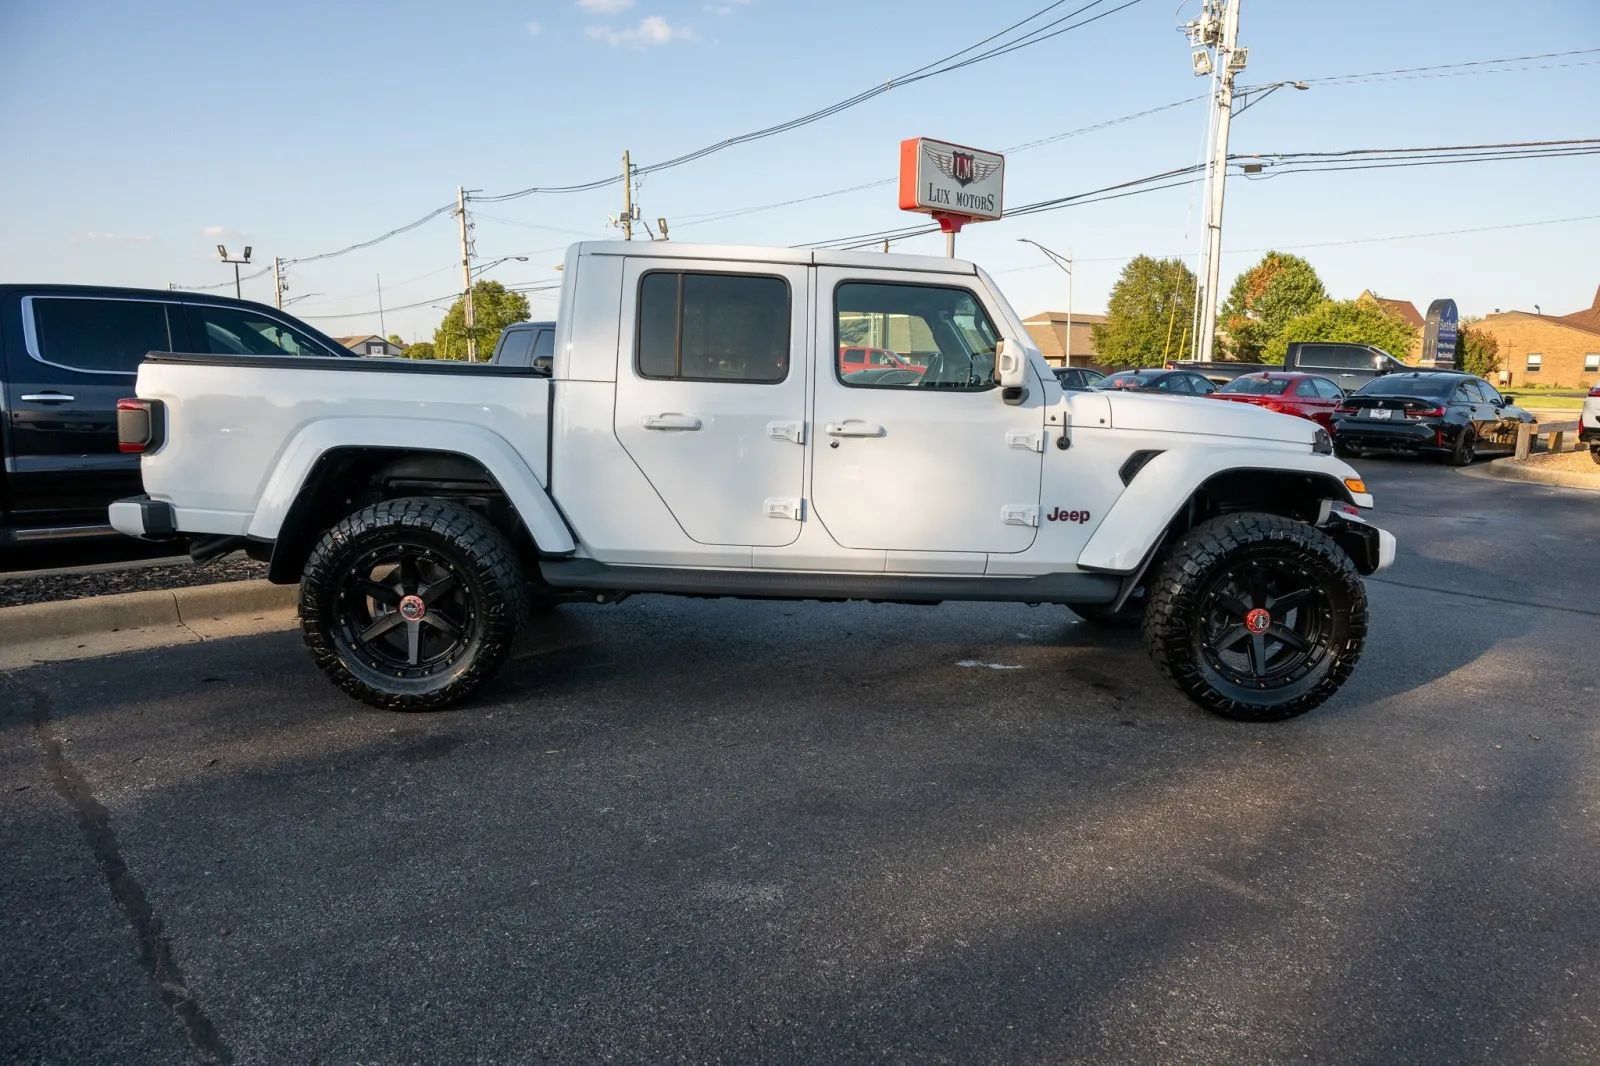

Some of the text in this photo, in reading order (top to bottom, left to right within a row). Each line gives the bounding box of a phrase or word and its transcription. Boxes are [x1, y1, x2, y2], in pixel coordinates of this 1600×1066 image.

[928, 182, 995, 212] LUX MOTORS
[1047, 506, 1090, 524] Jeep
